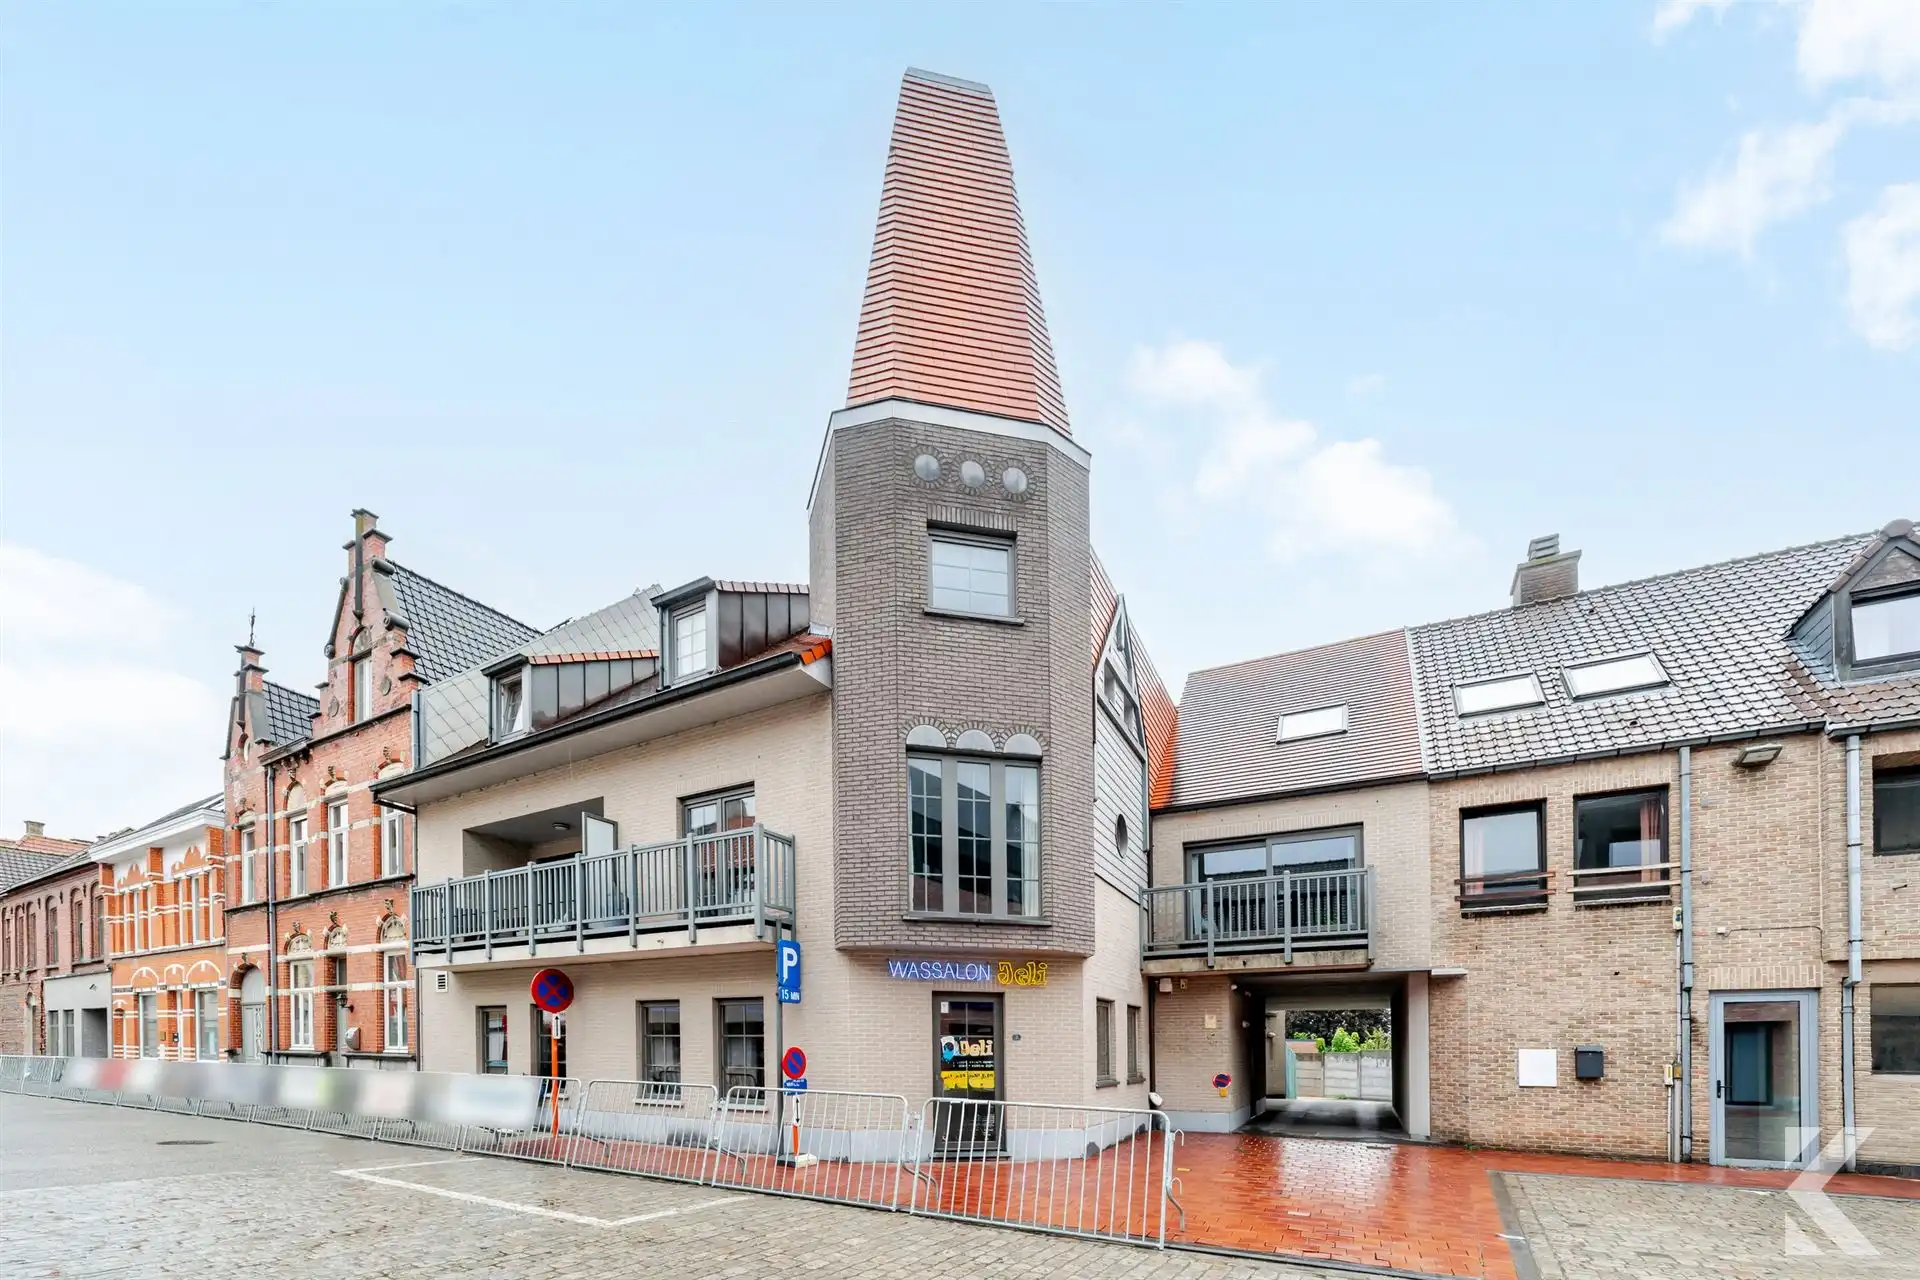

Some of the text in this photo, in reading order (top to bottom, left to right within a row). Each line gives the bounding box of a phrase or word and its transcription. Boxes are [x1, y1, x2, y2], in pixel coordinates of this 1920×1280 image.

[783, 947, 798, 984] P
[888, 960, 991, 981] WASSALON
[781, 989, 800, 1000] 15 MIN
